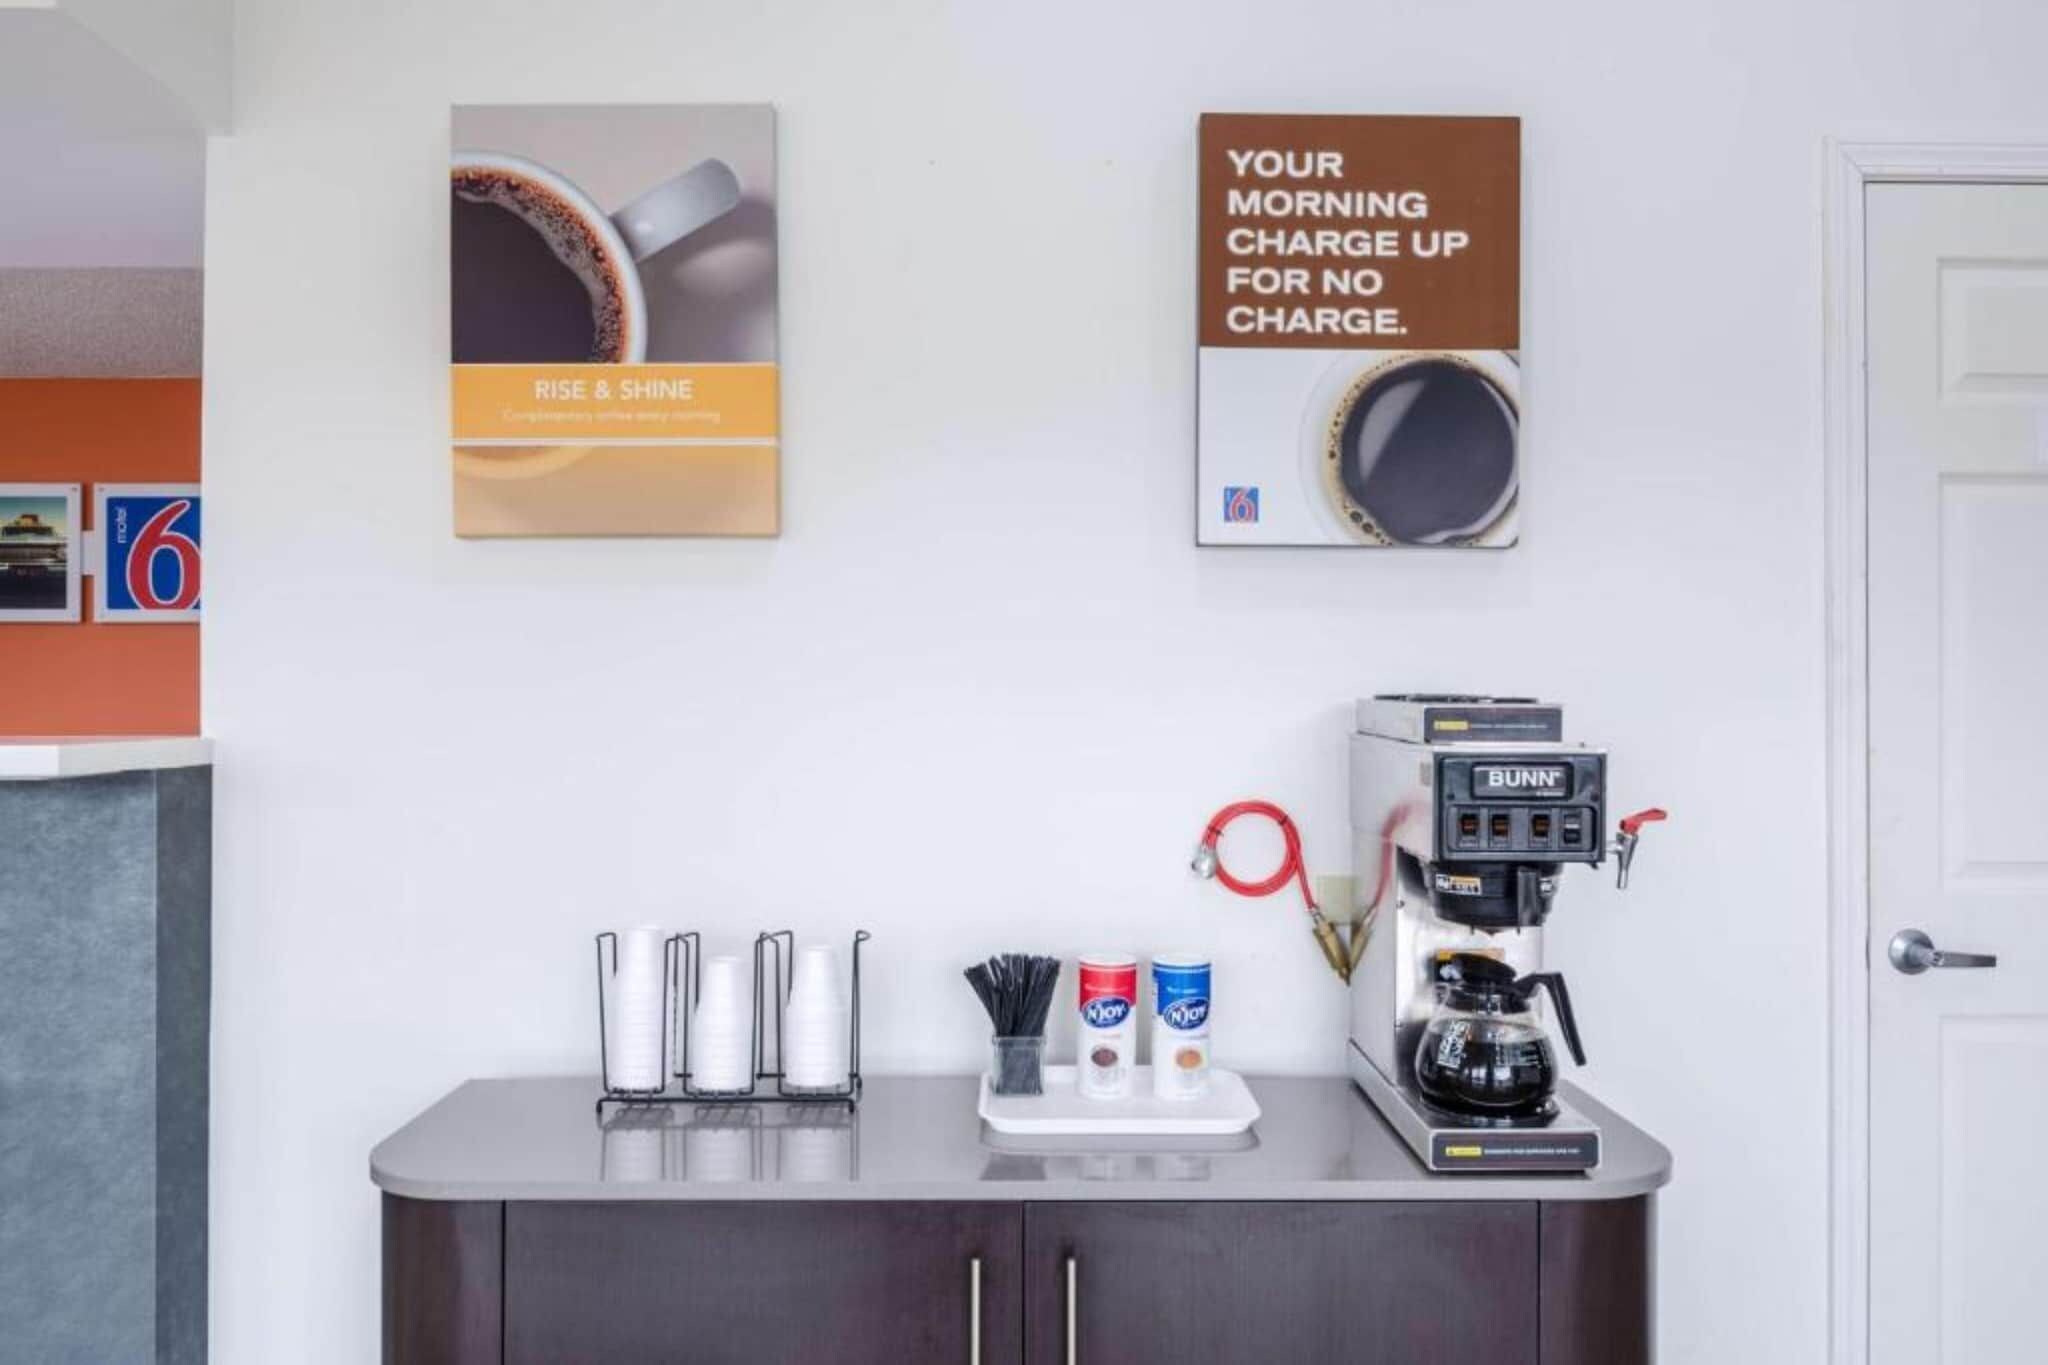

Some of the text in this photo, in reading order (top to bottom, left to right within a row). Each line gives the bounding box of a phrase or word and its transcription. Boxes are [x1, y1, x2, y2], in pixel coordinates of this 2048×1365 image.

[1226, 149, 1344, 178] YOUR
[1227, 189, 1428, 219] MORNING
[1226, 228, 1470, 258] CHARGE UP
[1227, 267, 1384, 296] FOR NO
[1226, 306, 1408, 335] CHARGE.
[534, 379, 694, 401] RISE & SHINE
[1228, 486, 1256, 524] 6
[126, 499, 201, 611] 6
[1489, 770, 1556, 788] BUNN
